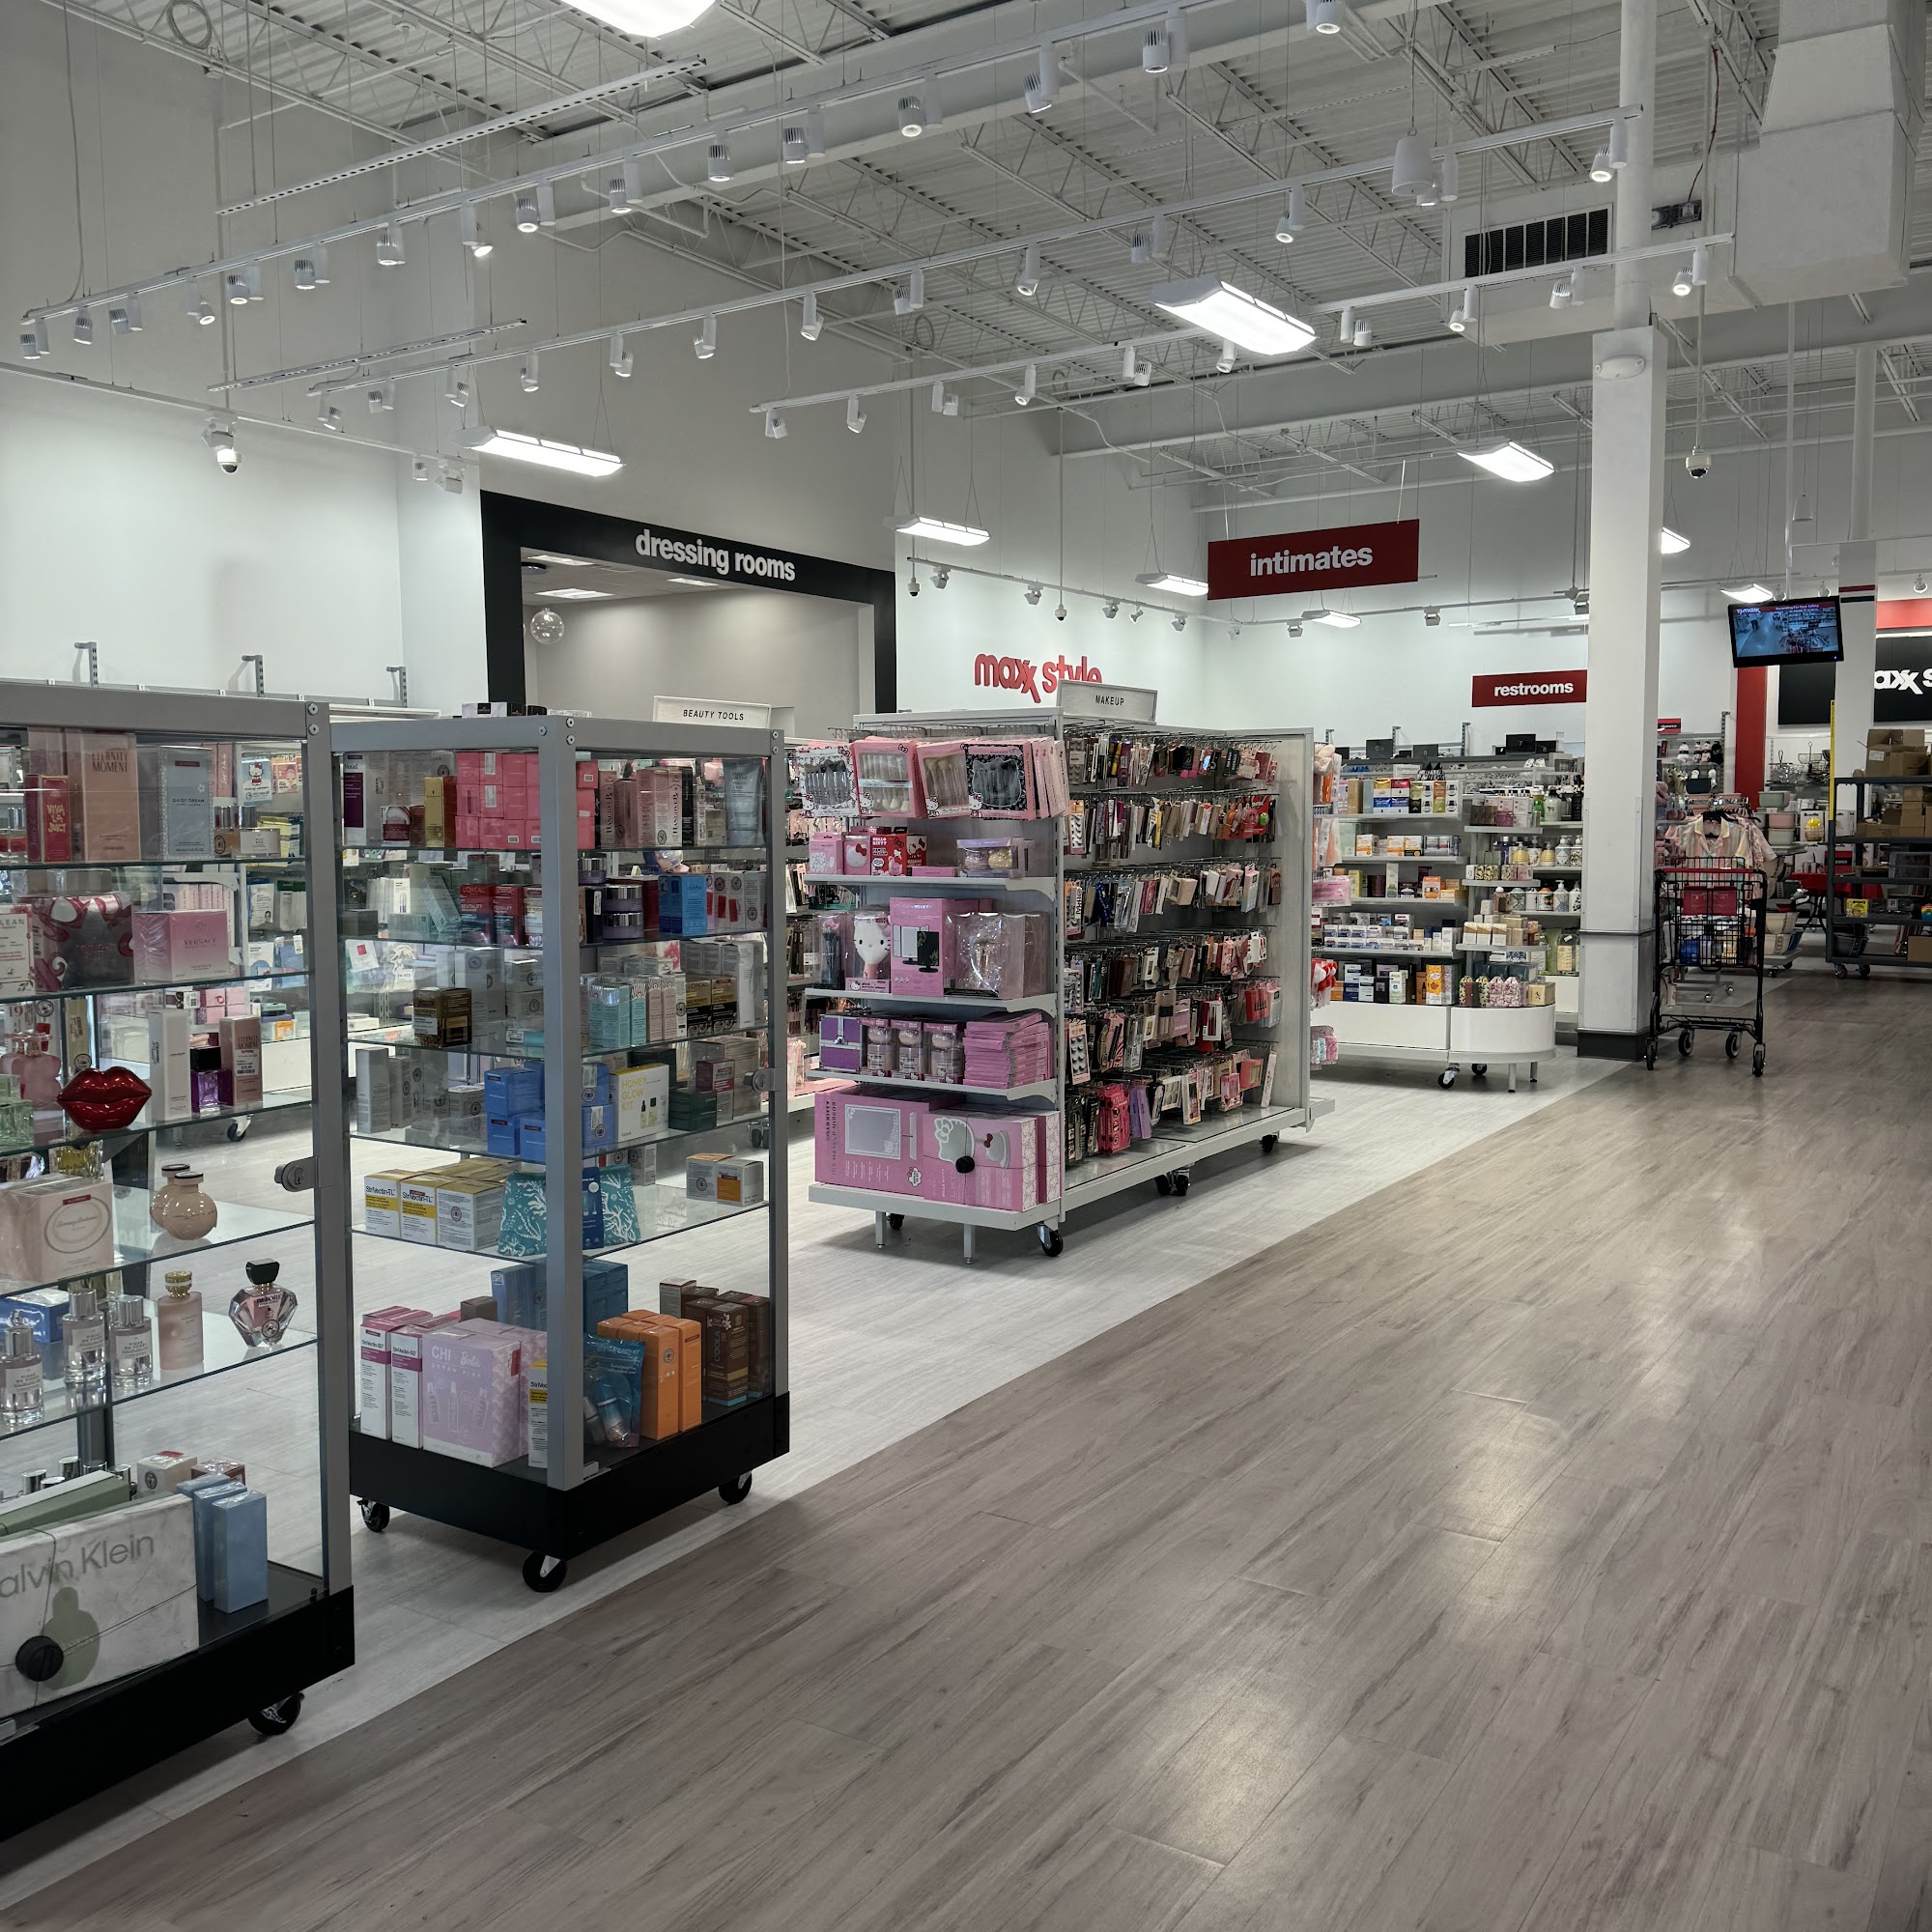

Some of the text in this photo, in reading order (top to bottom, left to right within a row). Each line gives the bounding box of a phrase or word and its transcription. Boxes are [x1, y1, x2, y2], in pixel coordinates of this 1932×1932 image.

[635, 528, 796, 581] dressing rooms
[1250, 546, 1374, 577] intimates
[975, 653, 1041, 703] maxx
[1874, 668, 1923, 695] axx
[1493, 682, 1575, 696] restrooms
[1095, 695, 1124, 706] MAKEUP
[683, 709, 744, 721] BEAUTY TOOLS
[92, 761, 128, 773] MOMENT
[46, 805, 65, 814] VIVA
[621, 1076, 647, 1088] HONEY
[621, 1088, 644, 1099] GLOW
[621, 1100, 634, 1112] KIT
[431, 1346, 481, 1367] CHI Barbie
[81, 1534, 155, 1574] Klein
